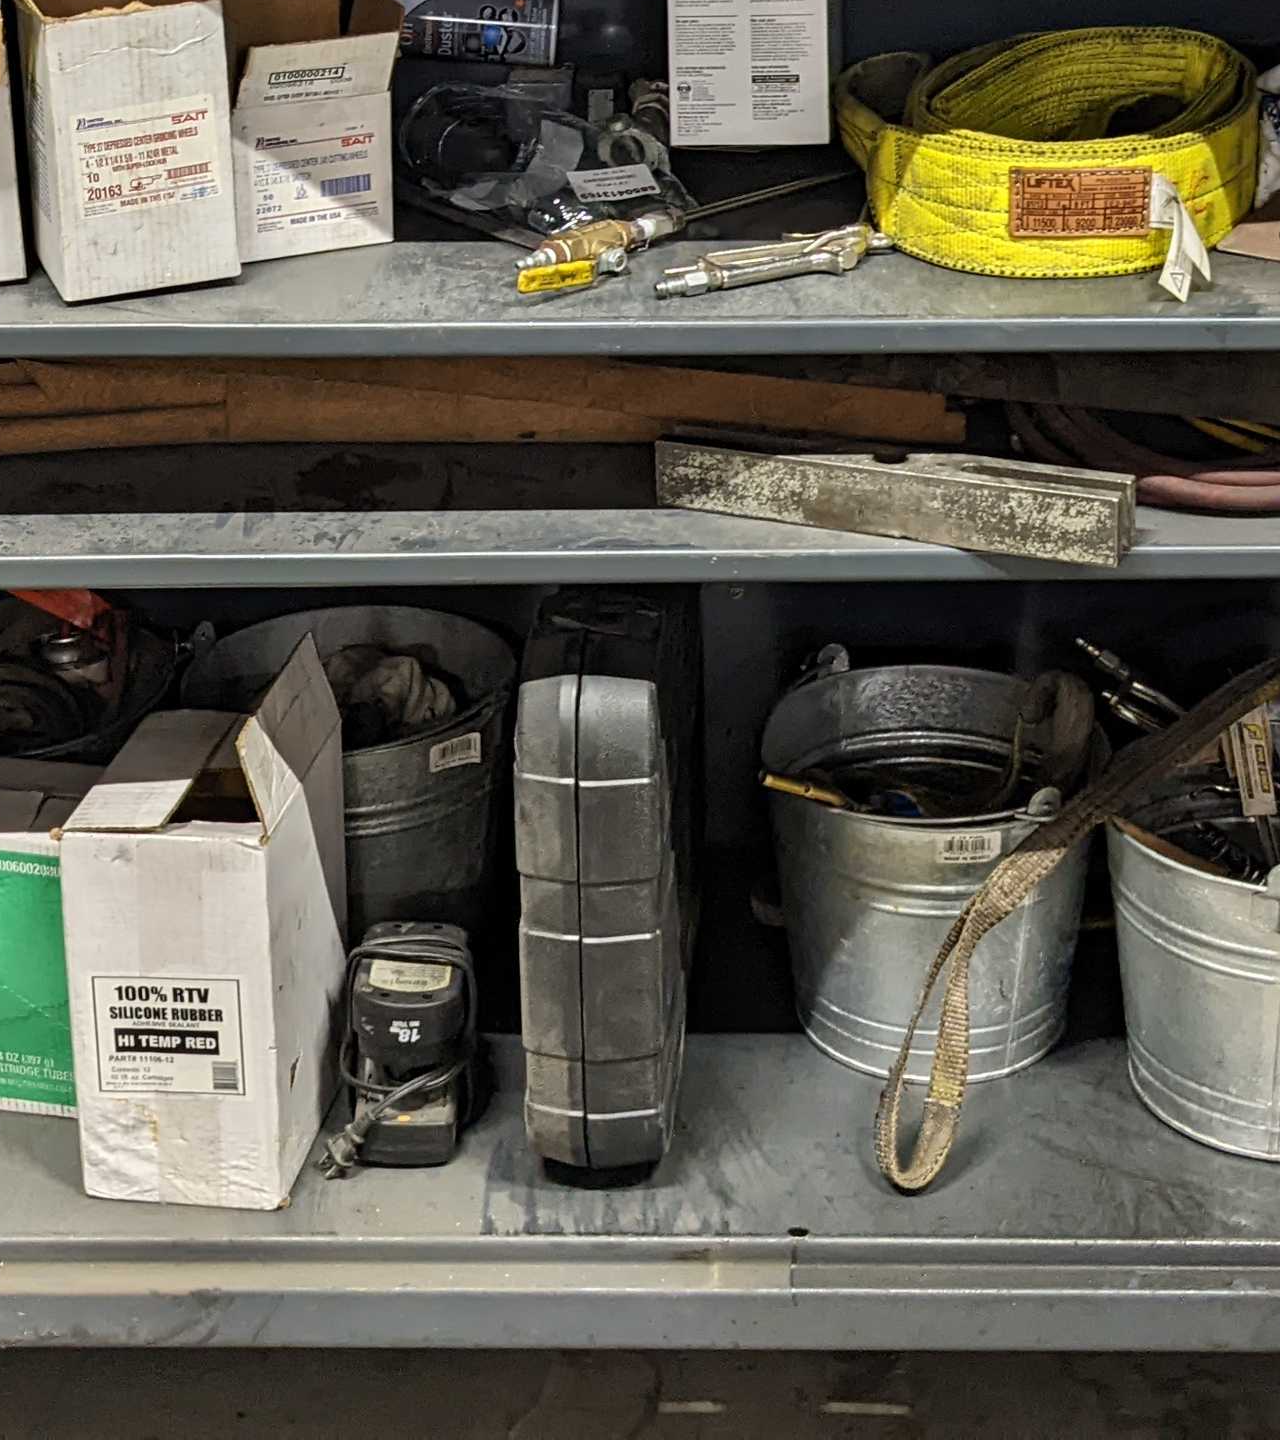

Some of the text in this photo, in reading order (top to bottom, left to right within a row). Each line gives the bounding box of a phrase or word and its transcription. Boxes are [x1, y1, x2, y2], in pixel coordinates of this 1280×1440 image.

[170, 109, 208, 125] SAIT
[133, 134, 152, 147] CENTER
[153, 130, 177, 143] GRINDING
[341, 134, 375, 148] SAIT
[86, 172, 100, 184] 10
[1027, 177, 1077, 192] LIFTEX
[87, 184, 122, 201] 20163
[120, 197, 139, 207] MADE
[290, 216, 308, 225] MADE
[318, 213, 329, 222] THE
[329, 212, 341, 221] USA
[1075, 217, 1096, 229] 9200
[114, 985, 209, 1003] 100% RTV
[109, 1006, 224, 1022] SILICONE RUBBER
[117, 1034, 217, 1050] HI TEMP RED
[395, 1028, 419, 1043] 18
[108, 1055, 137, 1063] PART#
